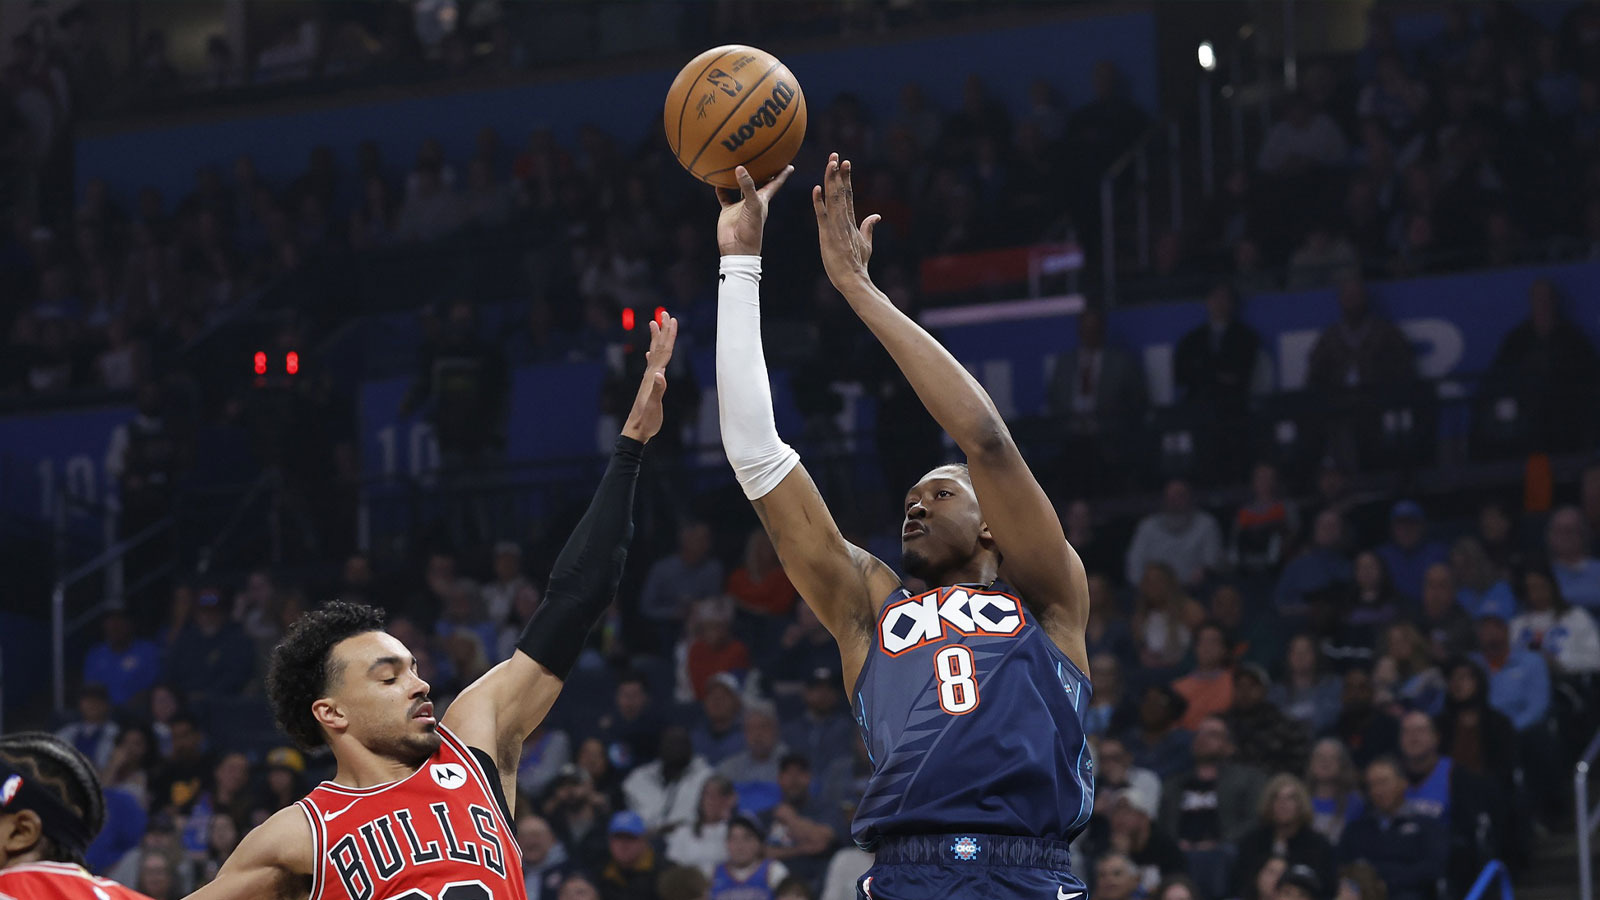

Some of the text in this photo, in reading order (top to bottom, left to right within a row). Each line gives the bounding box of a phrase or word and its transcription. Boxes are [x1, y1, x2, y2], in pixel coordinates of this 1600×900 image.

[721, 81, 795, 152] Wilson
[879, 586, 1025, 657] OKC
[934, 644, 980, 715] 8
[327, 801, 507, 900] BULLS
